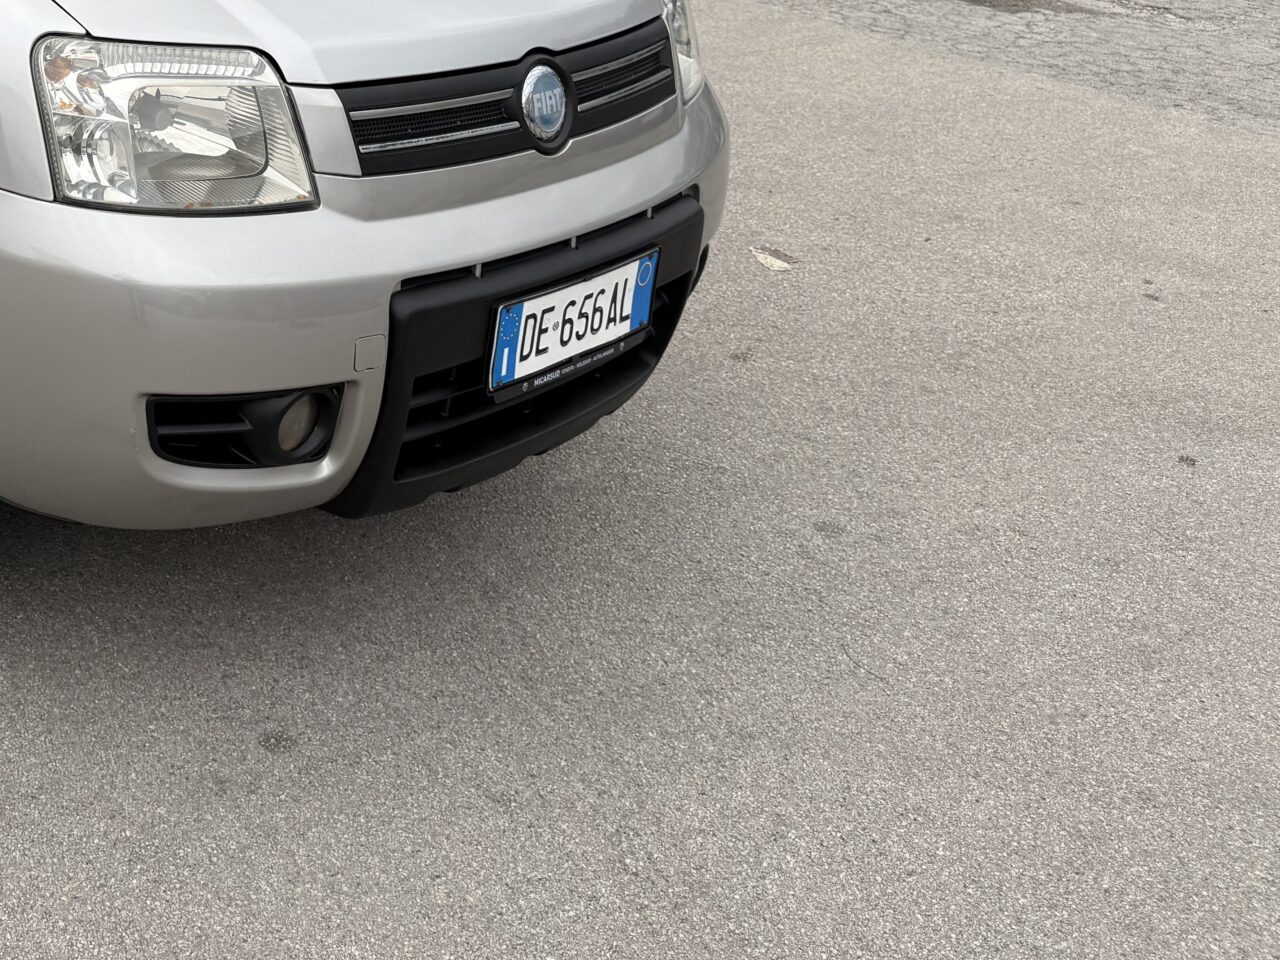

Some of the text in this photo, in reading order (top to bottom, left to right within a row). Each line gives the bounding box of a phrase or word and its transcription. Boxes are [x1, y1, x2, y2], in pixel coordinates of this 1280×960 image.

[532, 87, 561, 117] FIAT
[519, 305, 556, 363] DE
[559, 278, 631, 347] 656AL
